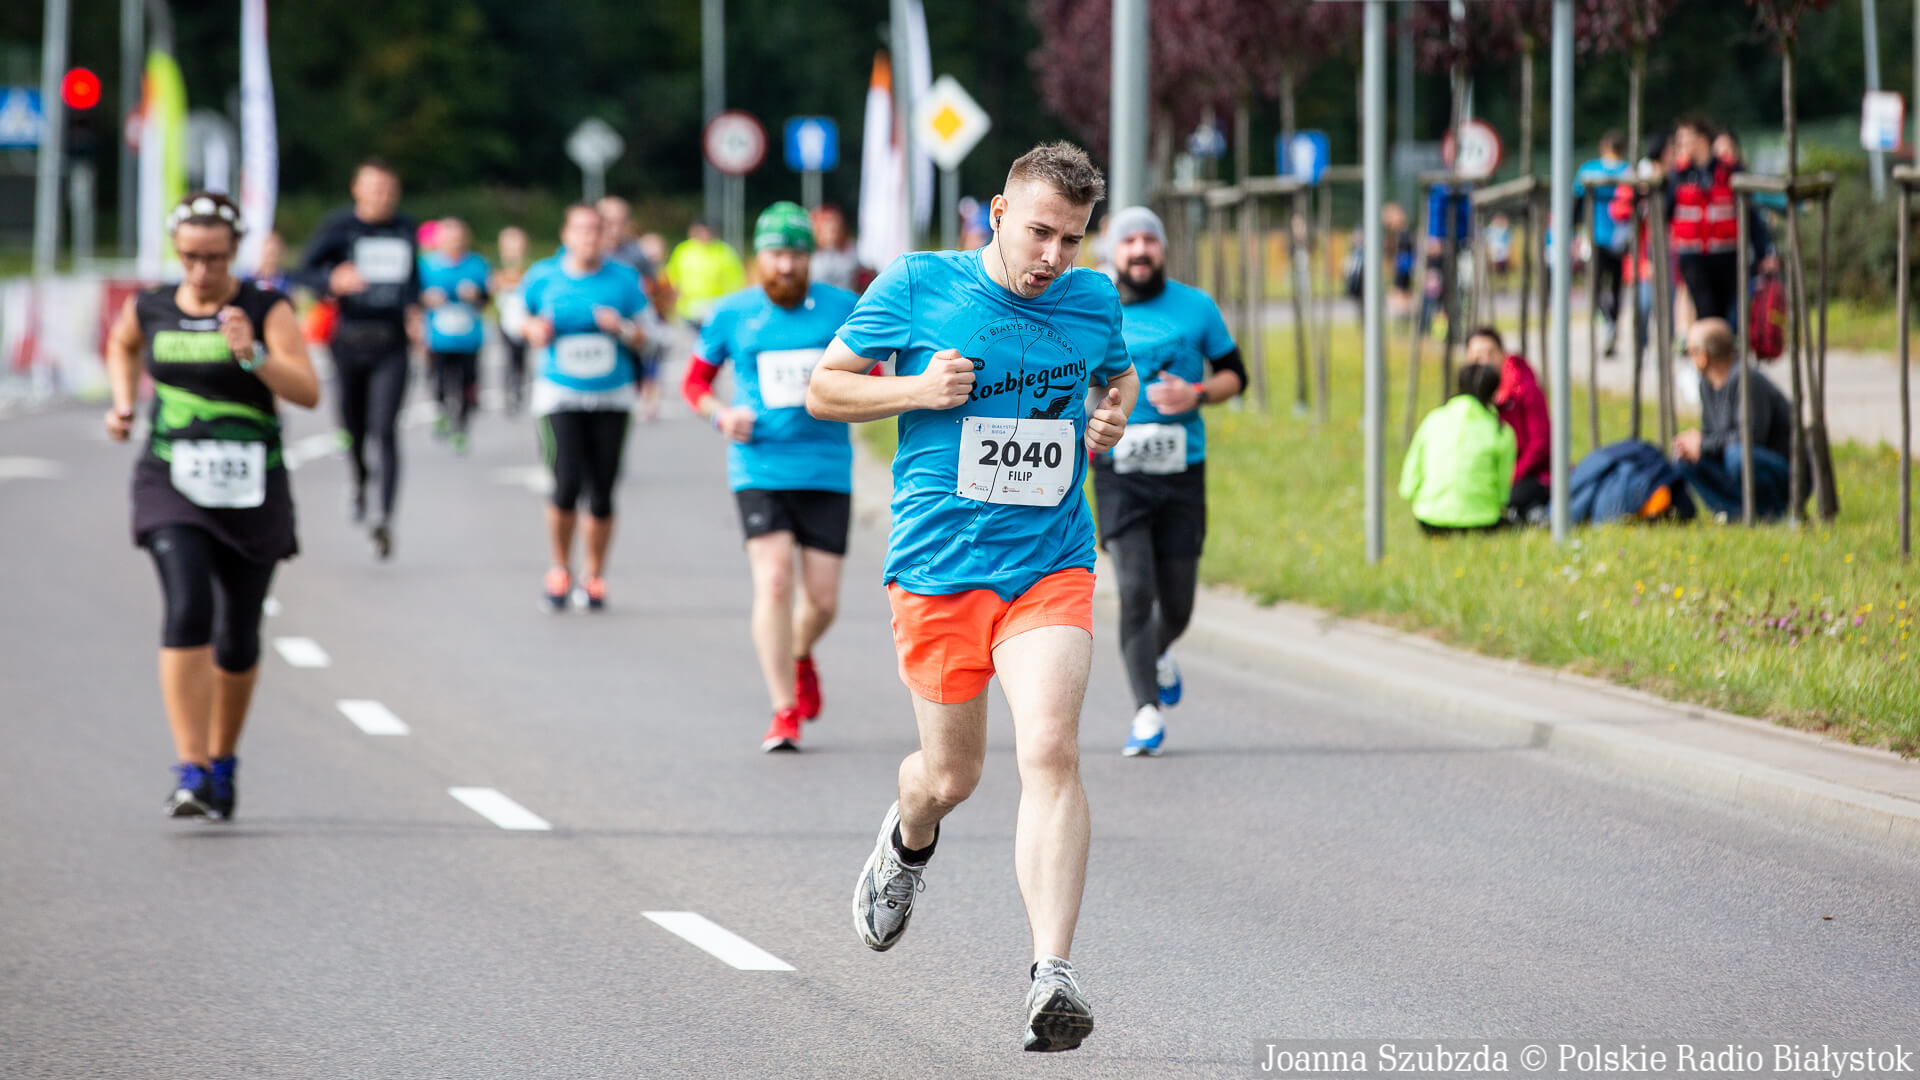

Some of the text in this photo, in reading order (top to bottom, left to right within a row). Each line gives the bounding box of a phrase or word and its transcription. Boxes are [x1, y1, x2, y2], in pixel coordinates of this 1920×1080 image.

[989, 323, 1044, 336] BIAŁYSTOK
[979, 440, 1062, 468] 2040
[1008, 471, 1033, 481] FILIP
